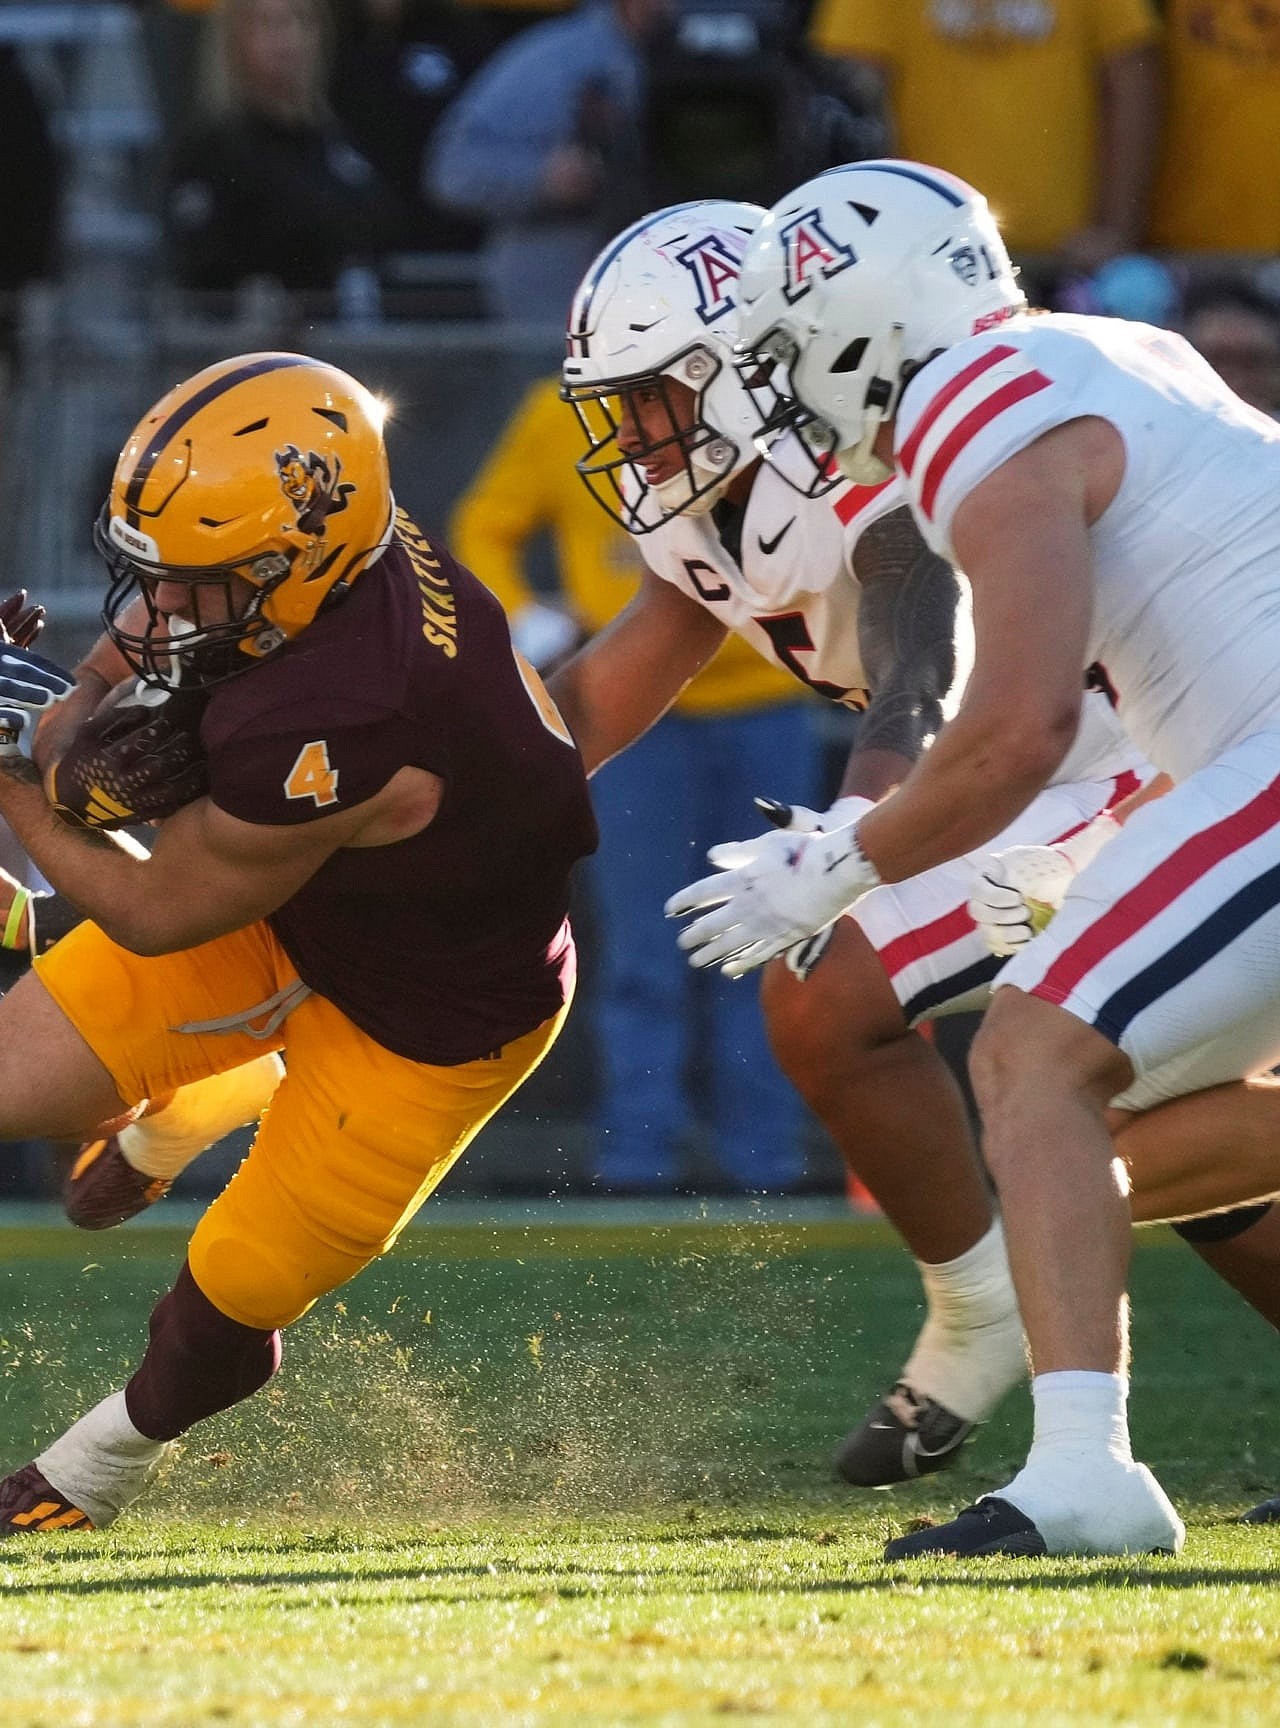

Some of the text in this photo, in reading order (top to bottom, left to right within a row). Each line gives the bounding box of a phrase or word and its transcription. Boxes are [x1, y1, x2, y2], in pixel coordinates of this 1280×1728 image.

[676, 234, 742, 326] A
[780, 207, 858, 306] A
[682, 558, 731, 601] C
[284, 740, 339, 808] 4
